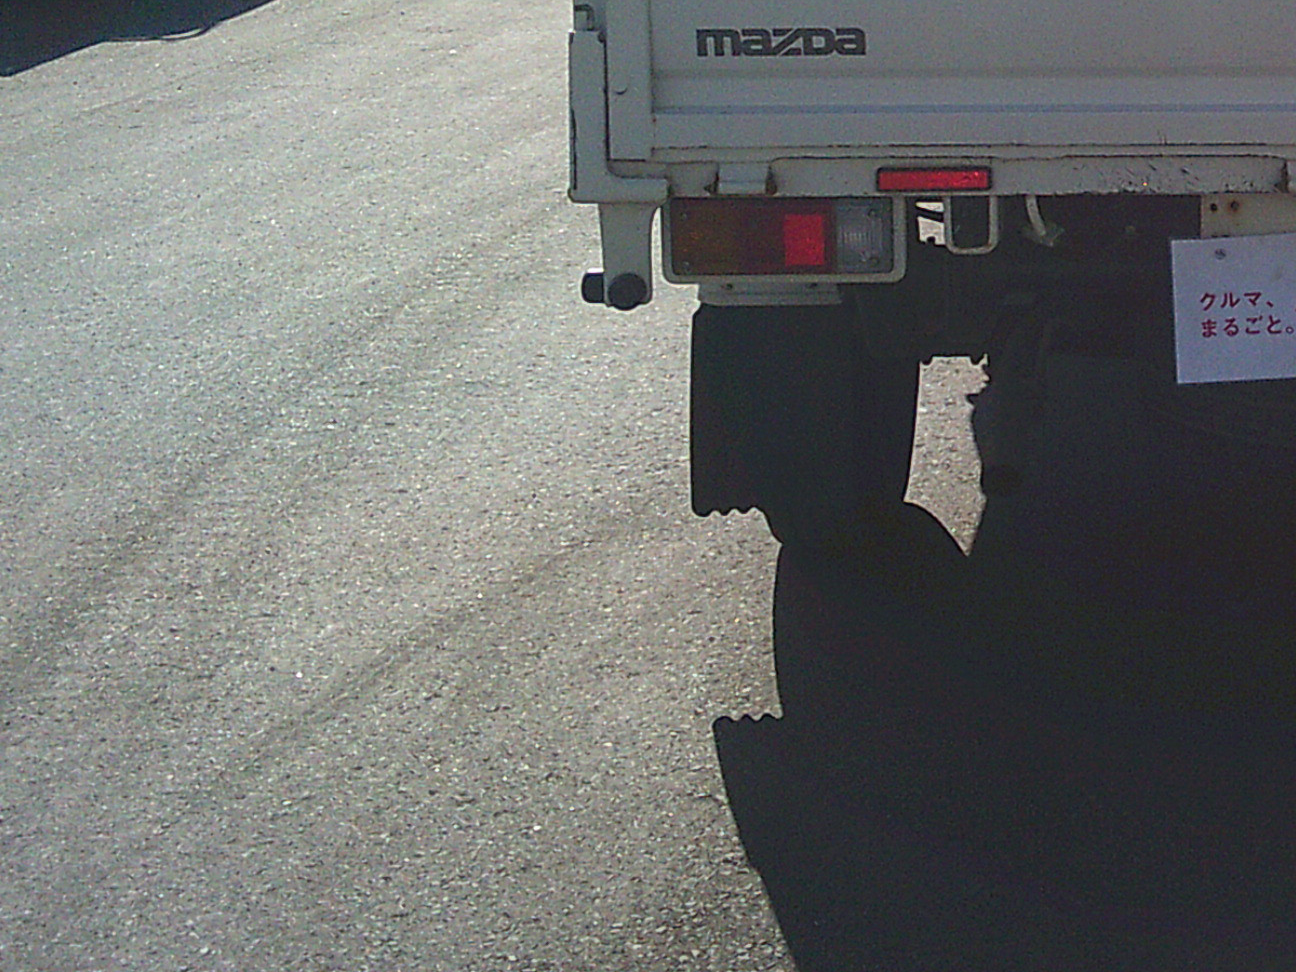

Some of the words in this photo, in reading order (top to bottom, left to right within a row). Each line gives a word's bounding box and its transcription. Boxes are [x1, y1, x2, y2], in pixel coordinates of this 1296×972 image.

[696, 28, 867, 56] mazda
[1199, 290, 1275, 312] クルマ、
[1201, 314, 1295, 338] まるごと。
